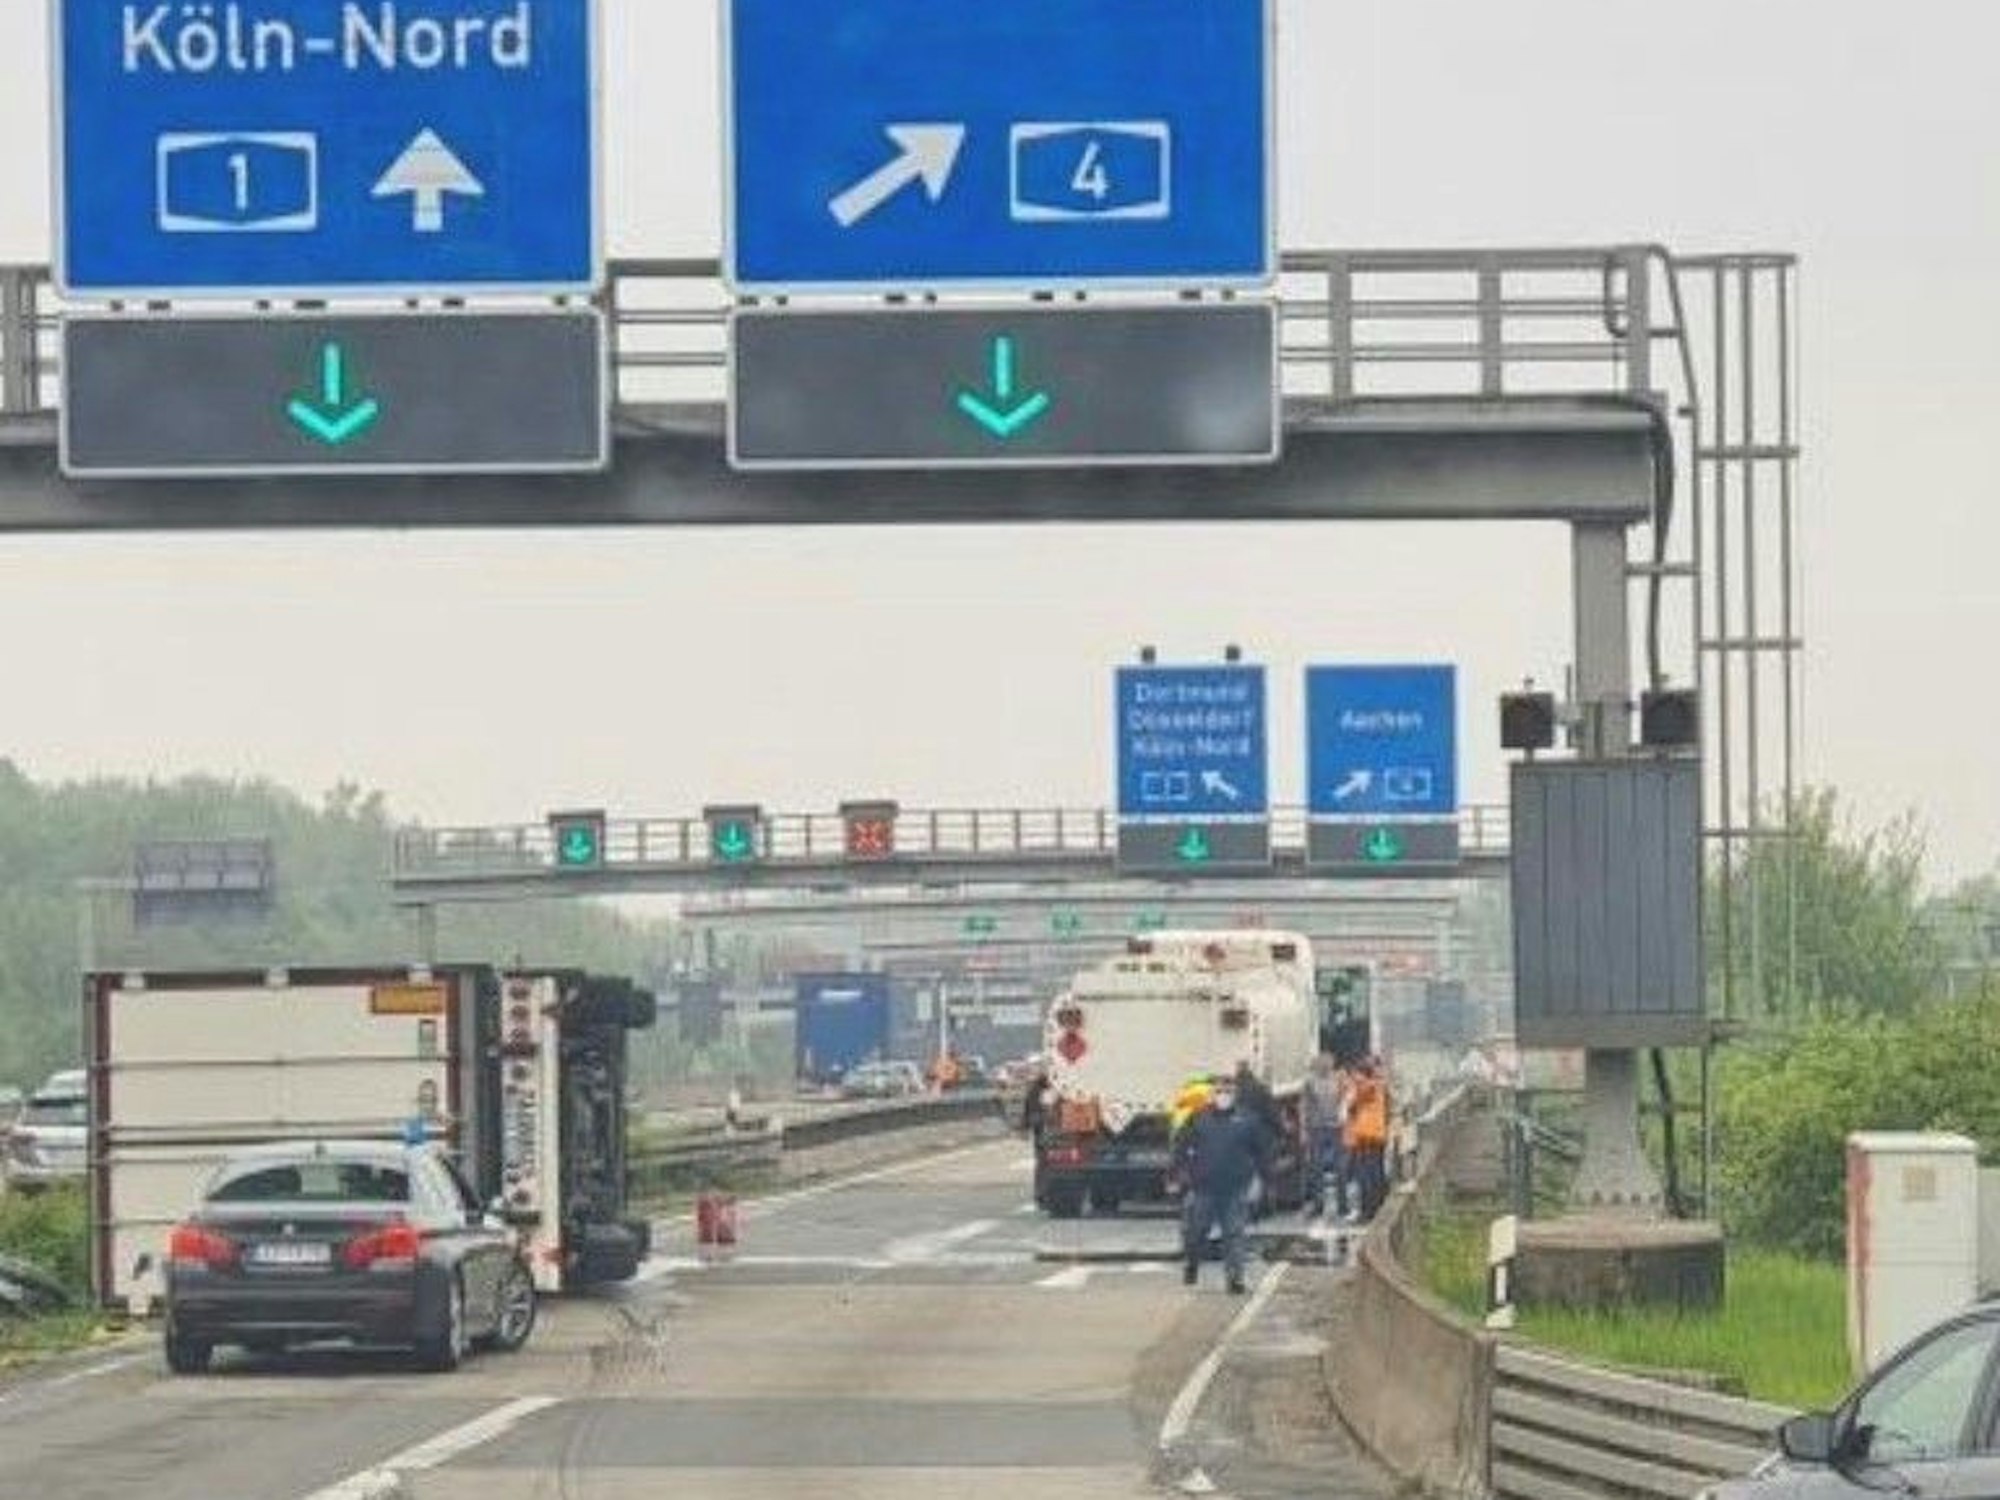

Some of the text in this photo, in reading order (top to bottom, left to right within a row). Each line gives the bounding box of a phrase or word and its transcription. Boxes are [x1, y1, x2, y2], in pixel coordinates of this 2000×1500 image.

[122, 1, 531, 72] Köln-Nord
[229, 153, 248, 210] 1
[1071, 141, 1109, 199] 4
